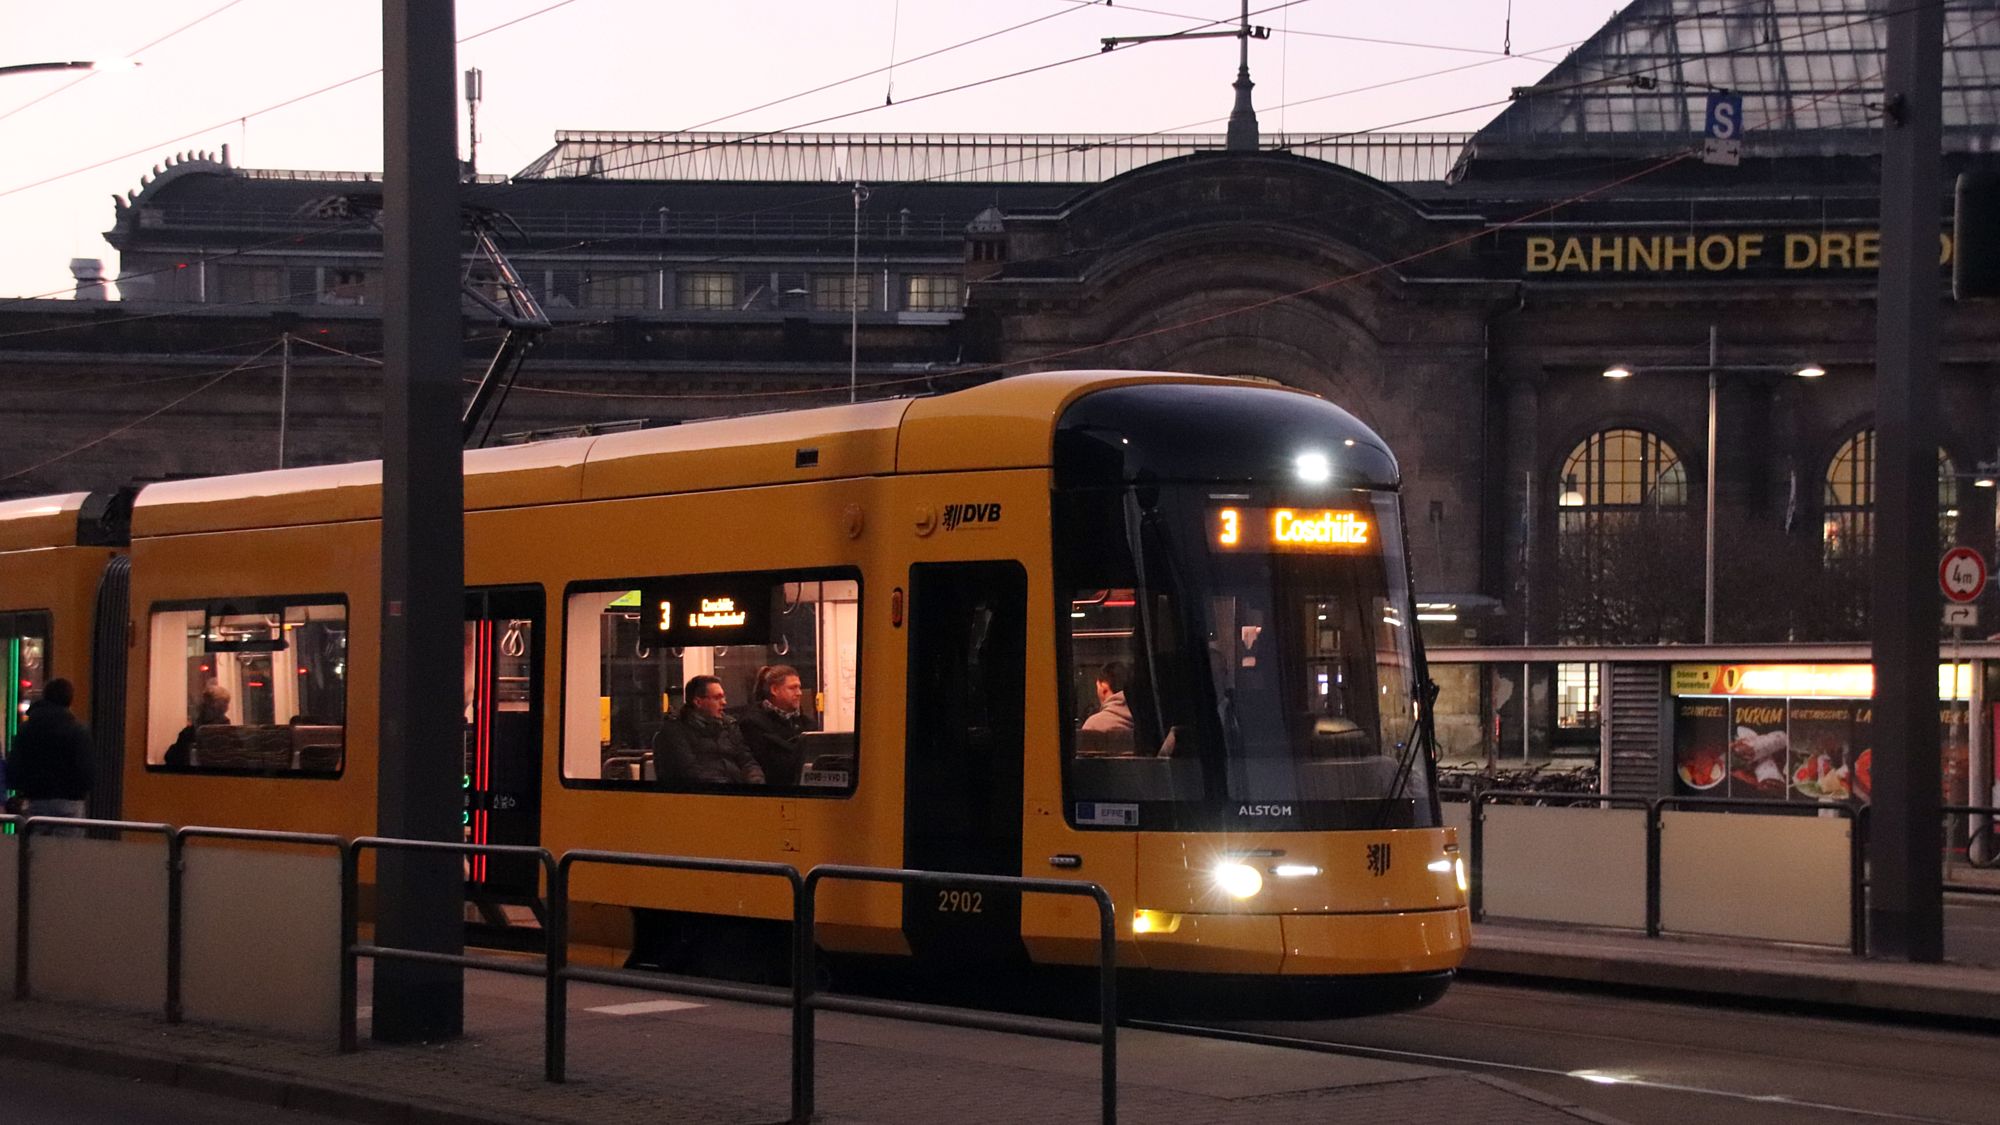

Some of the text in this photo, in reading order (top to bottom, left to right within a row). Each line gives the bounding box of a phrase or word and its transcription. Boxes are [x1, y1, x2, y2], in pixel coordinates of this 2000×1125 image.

[1713, 102, 1734, 140] S
[1526, 234, 1764, 272] BAHNHOF
[962, 503, 1002, 523] DVB
[1220, 509, 1368, 544] 3 Coschütz
[660, 601, 671, 631] 3
[1238, 805, 1292, 816] ALSTOM
[938, 890, 982, 912] 2902
